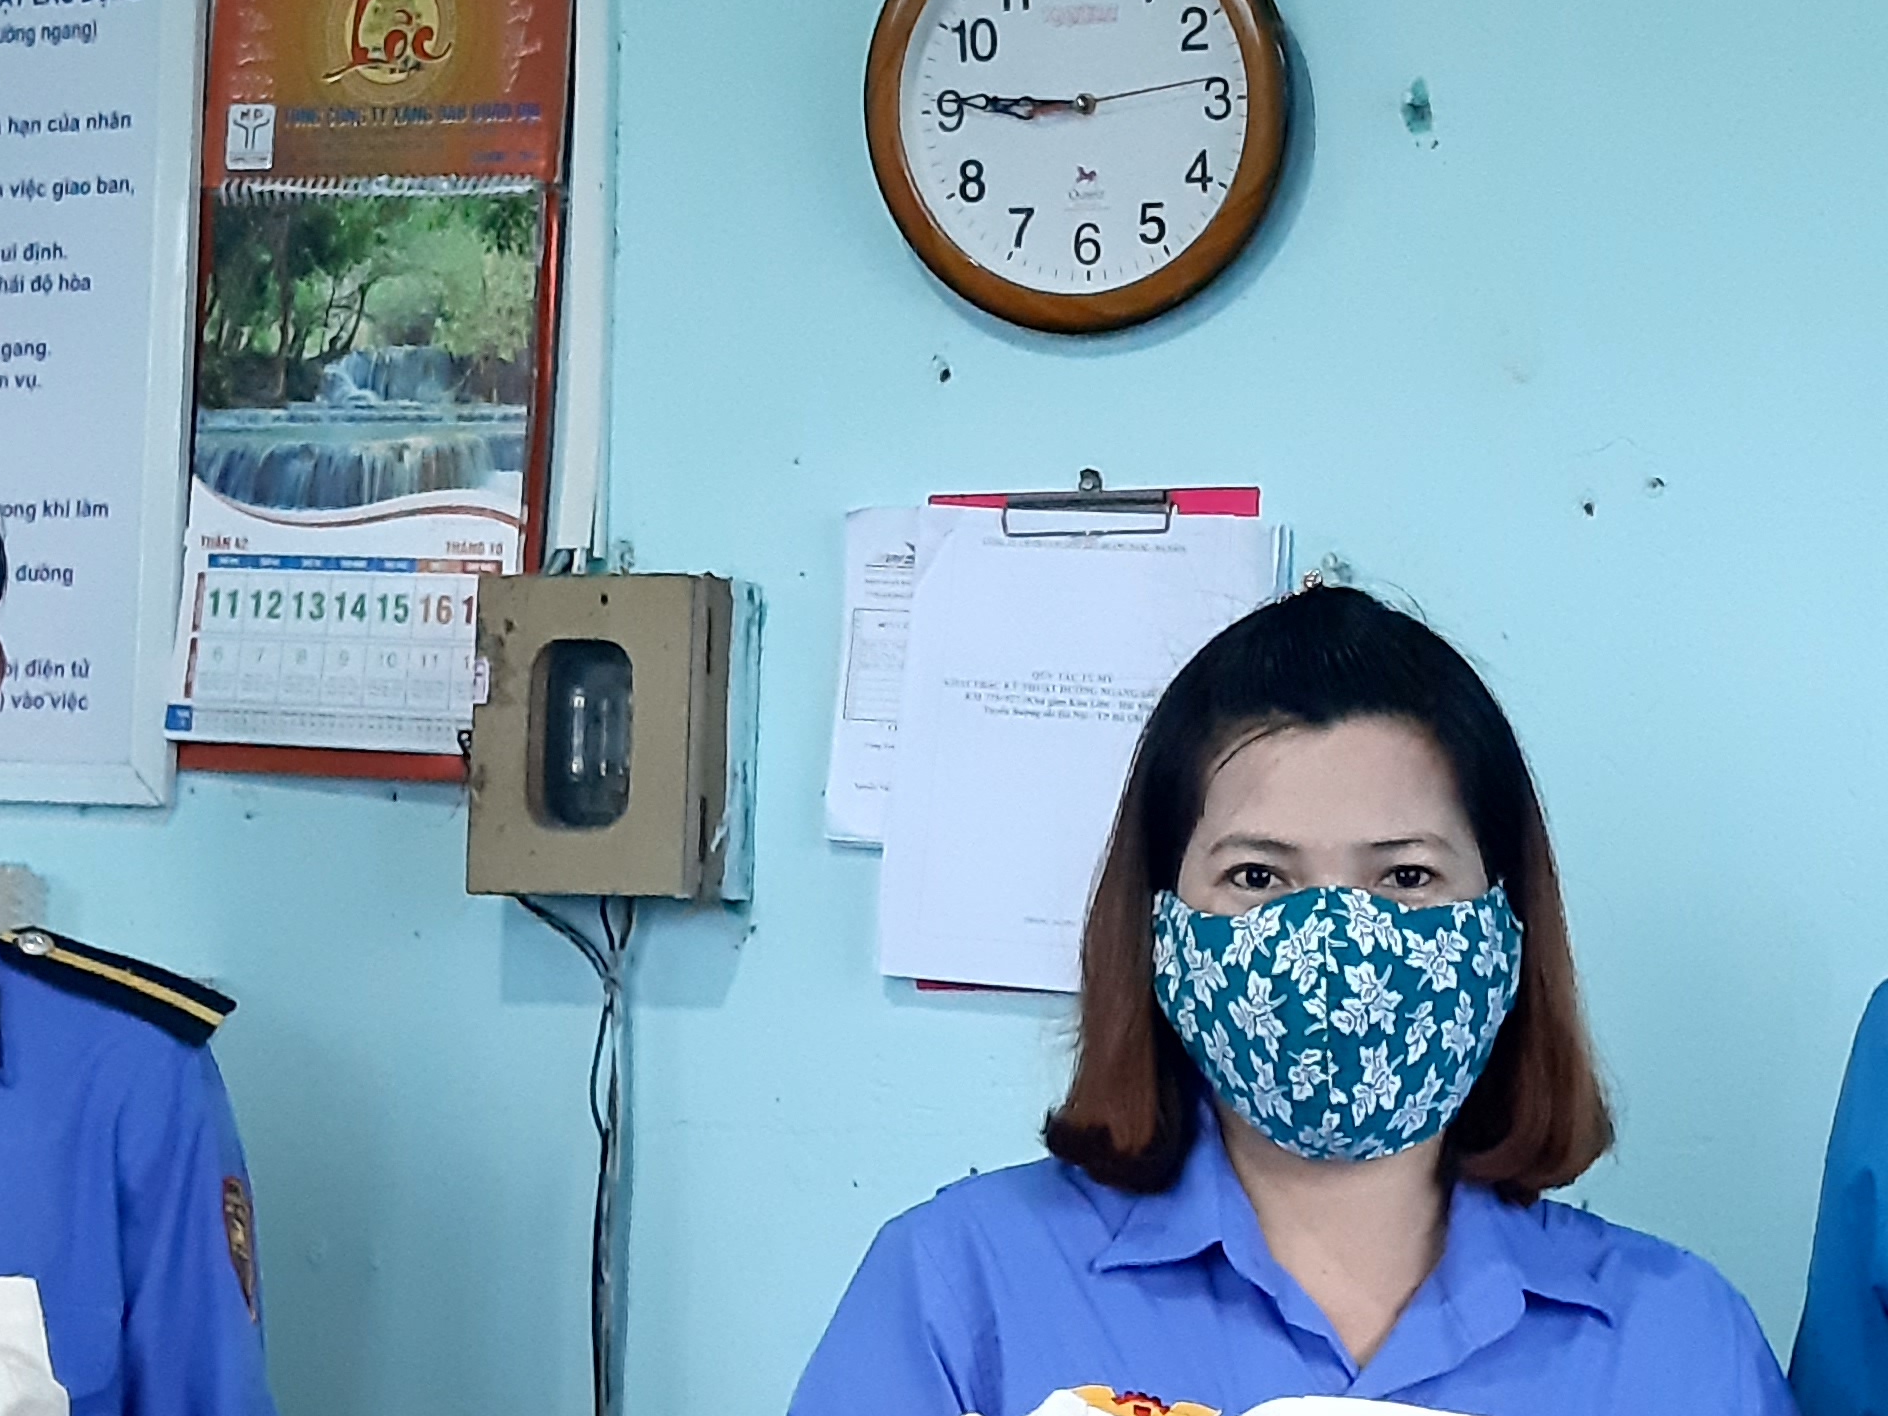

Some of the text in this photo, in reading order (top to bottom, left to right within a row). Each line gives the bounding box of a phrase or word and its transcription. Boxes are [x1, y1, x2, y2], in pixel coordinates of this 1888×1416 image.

[950, 17, 998, 62] 10
[1180, 6, 1210, 51] 2
[936, 89, 965, 132] 9
[1204, 75, 1232, 121] 3
[958, 159, 986, 203] 8
[1185, 149, 1214, 193] 4
[1008, 206, 1035, 249] 7
[1073, 222, 1102, 266] 6
[1139, 201, 1167, 245] 5
[209, 588, 239, 619] 11
[250, 589, 283, 619] 12
[292, 590, 326, 620] 13
[334, 591, 367, 622] 14
[376, 592, 410, 624] 15
[419, 593, 453, 625] 16
